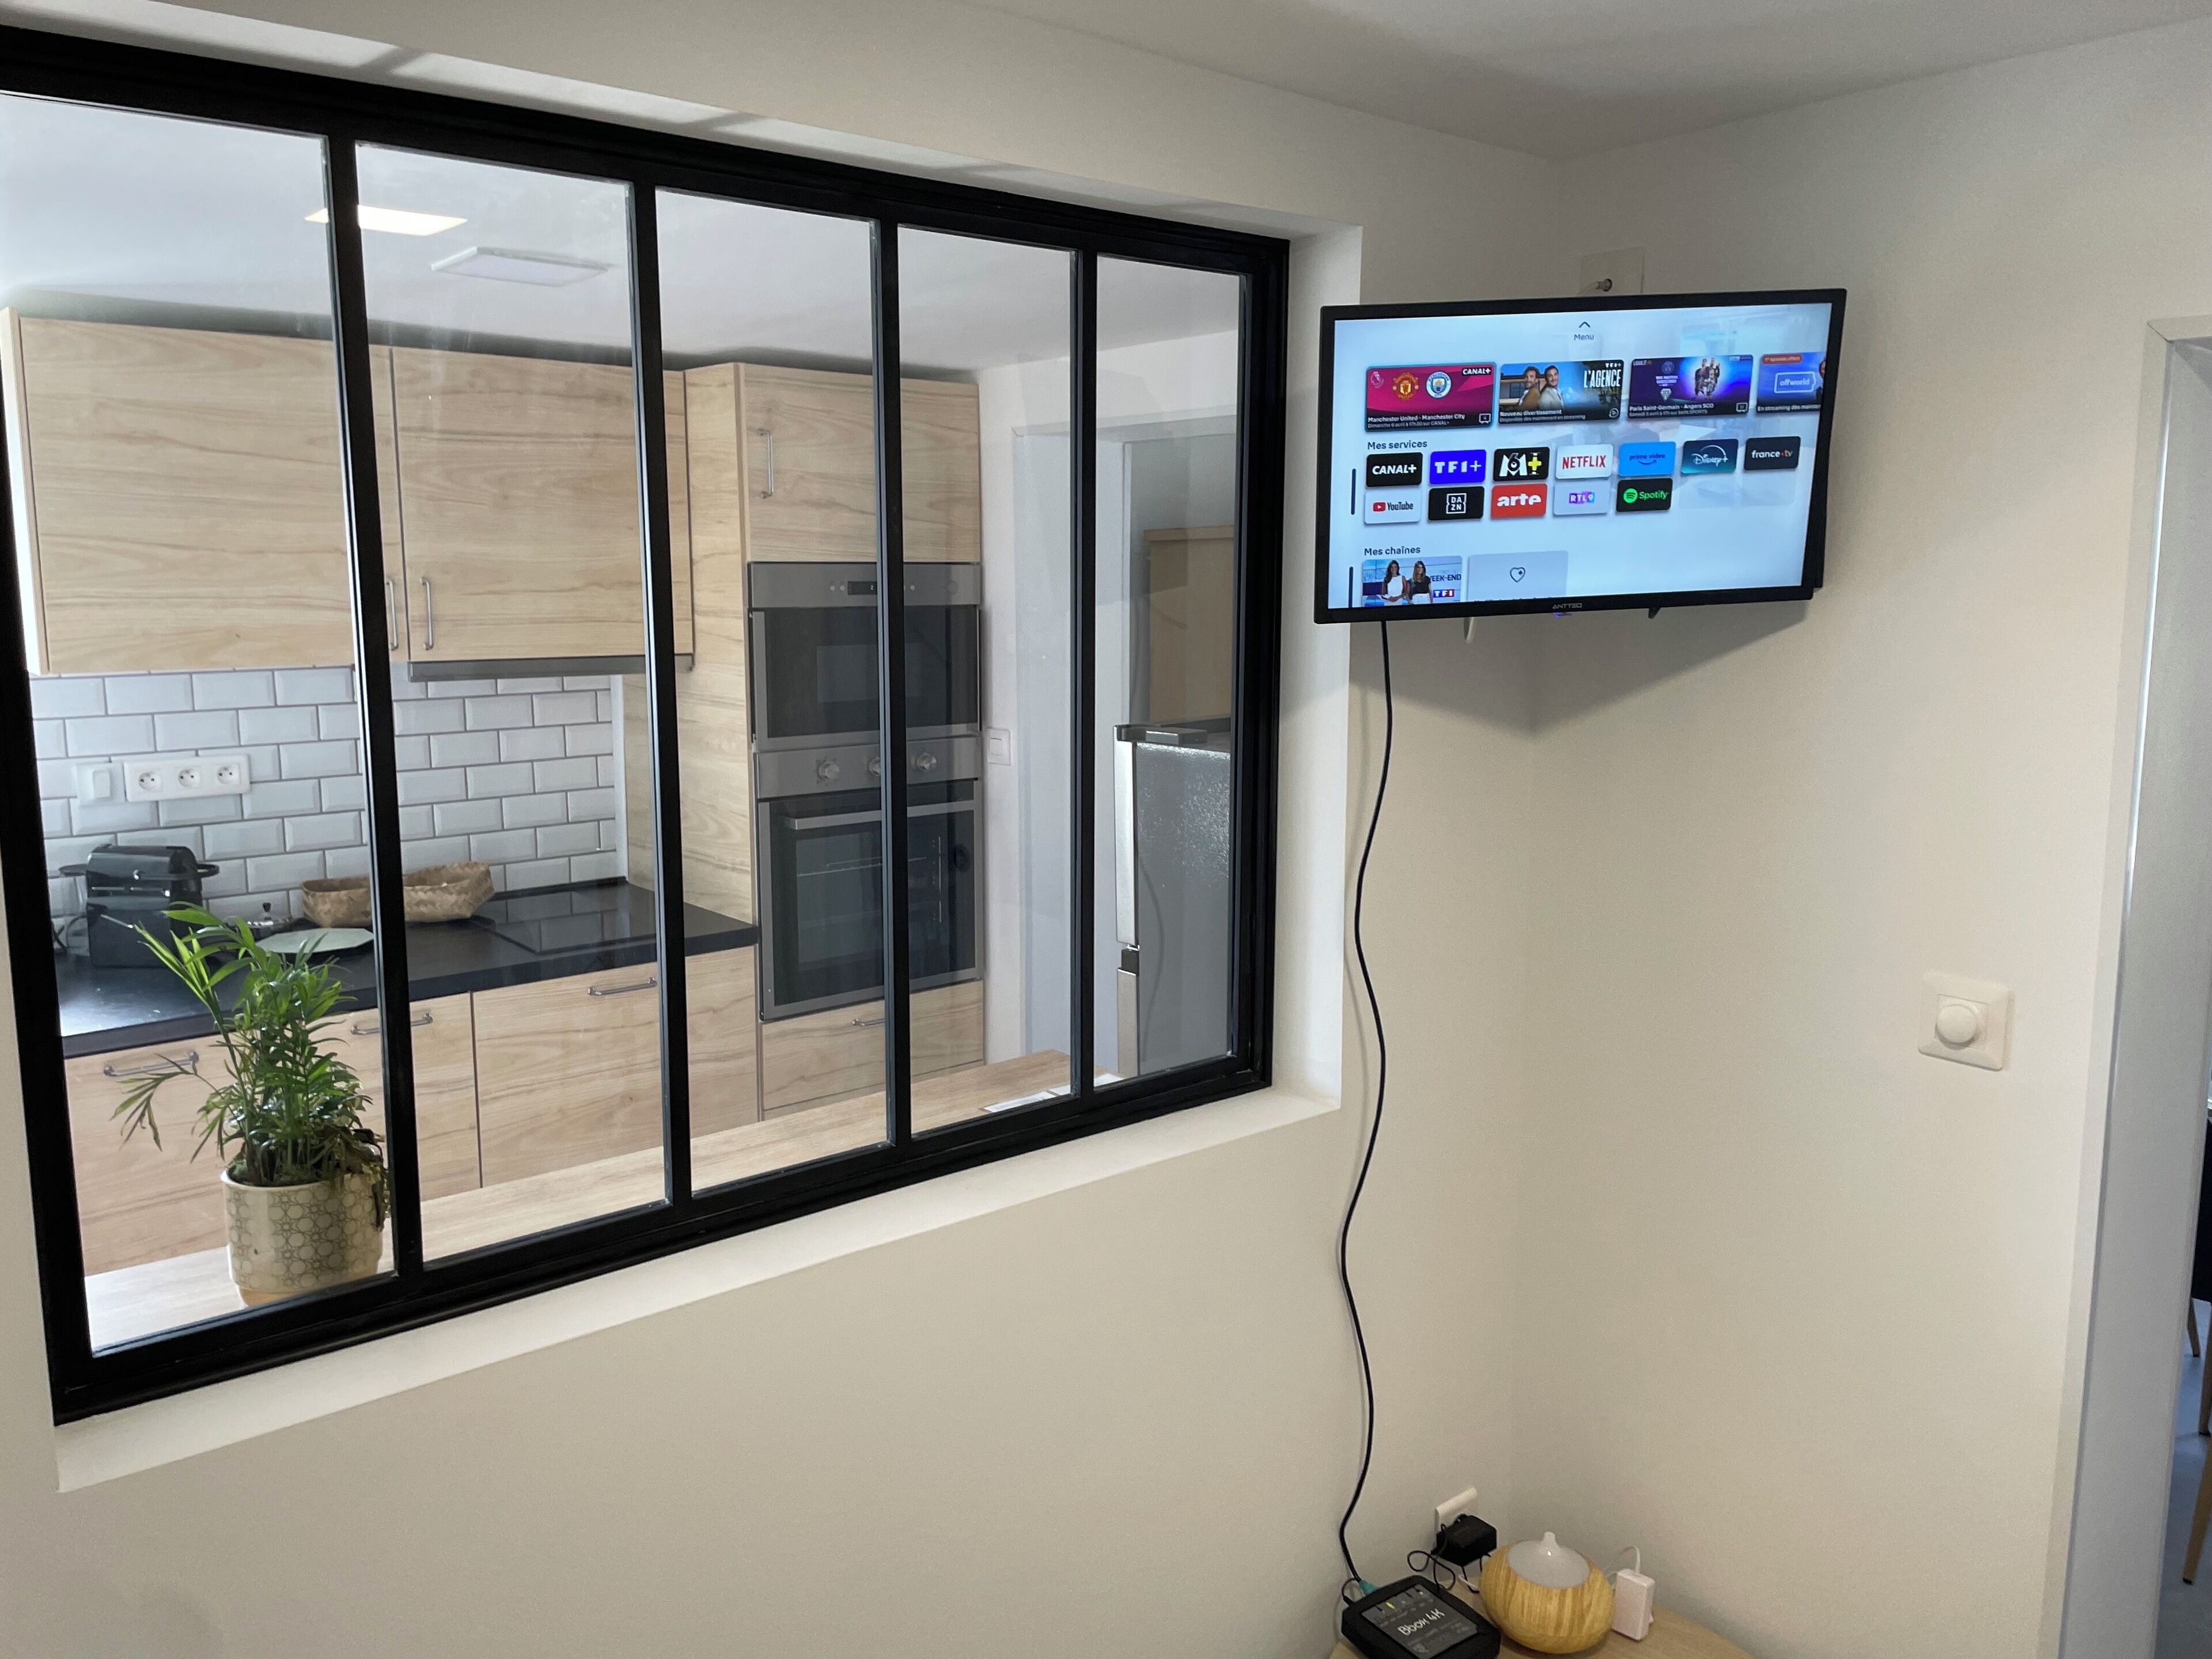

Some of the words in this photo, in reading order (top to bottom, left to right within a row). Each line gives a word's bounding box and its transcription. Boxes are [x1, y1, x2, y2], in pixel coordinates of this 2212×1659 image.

[1463, 368, 1491, 376] CANAL+
[1584, 369, 1622, 388] L'AGENCE
[1368, 415, 1400, 423] Manchester
[1367, 441, 1386, 450] Mes
[1388, 440, 1427, 449] services
[1434, 460, 1482, 474] TF1+
[1562, 455, 1607, 469] NETFLIX
[1372, 464, 1417, 475] CANAL+
[1497, 493, 1542, 507] arte
[1570, 493, 1594, 503] RTL9
[1639, 490, 1668, 500] Spotify
[1387, 501, 1414, 511] YouTube
[1364, 547, 1382, 556] Mes
[1385, 545, 1421, 555] chaînes
[1434, 590, 1454, 598] TF1
[1425, 1608, 1445, 1622] 4K
